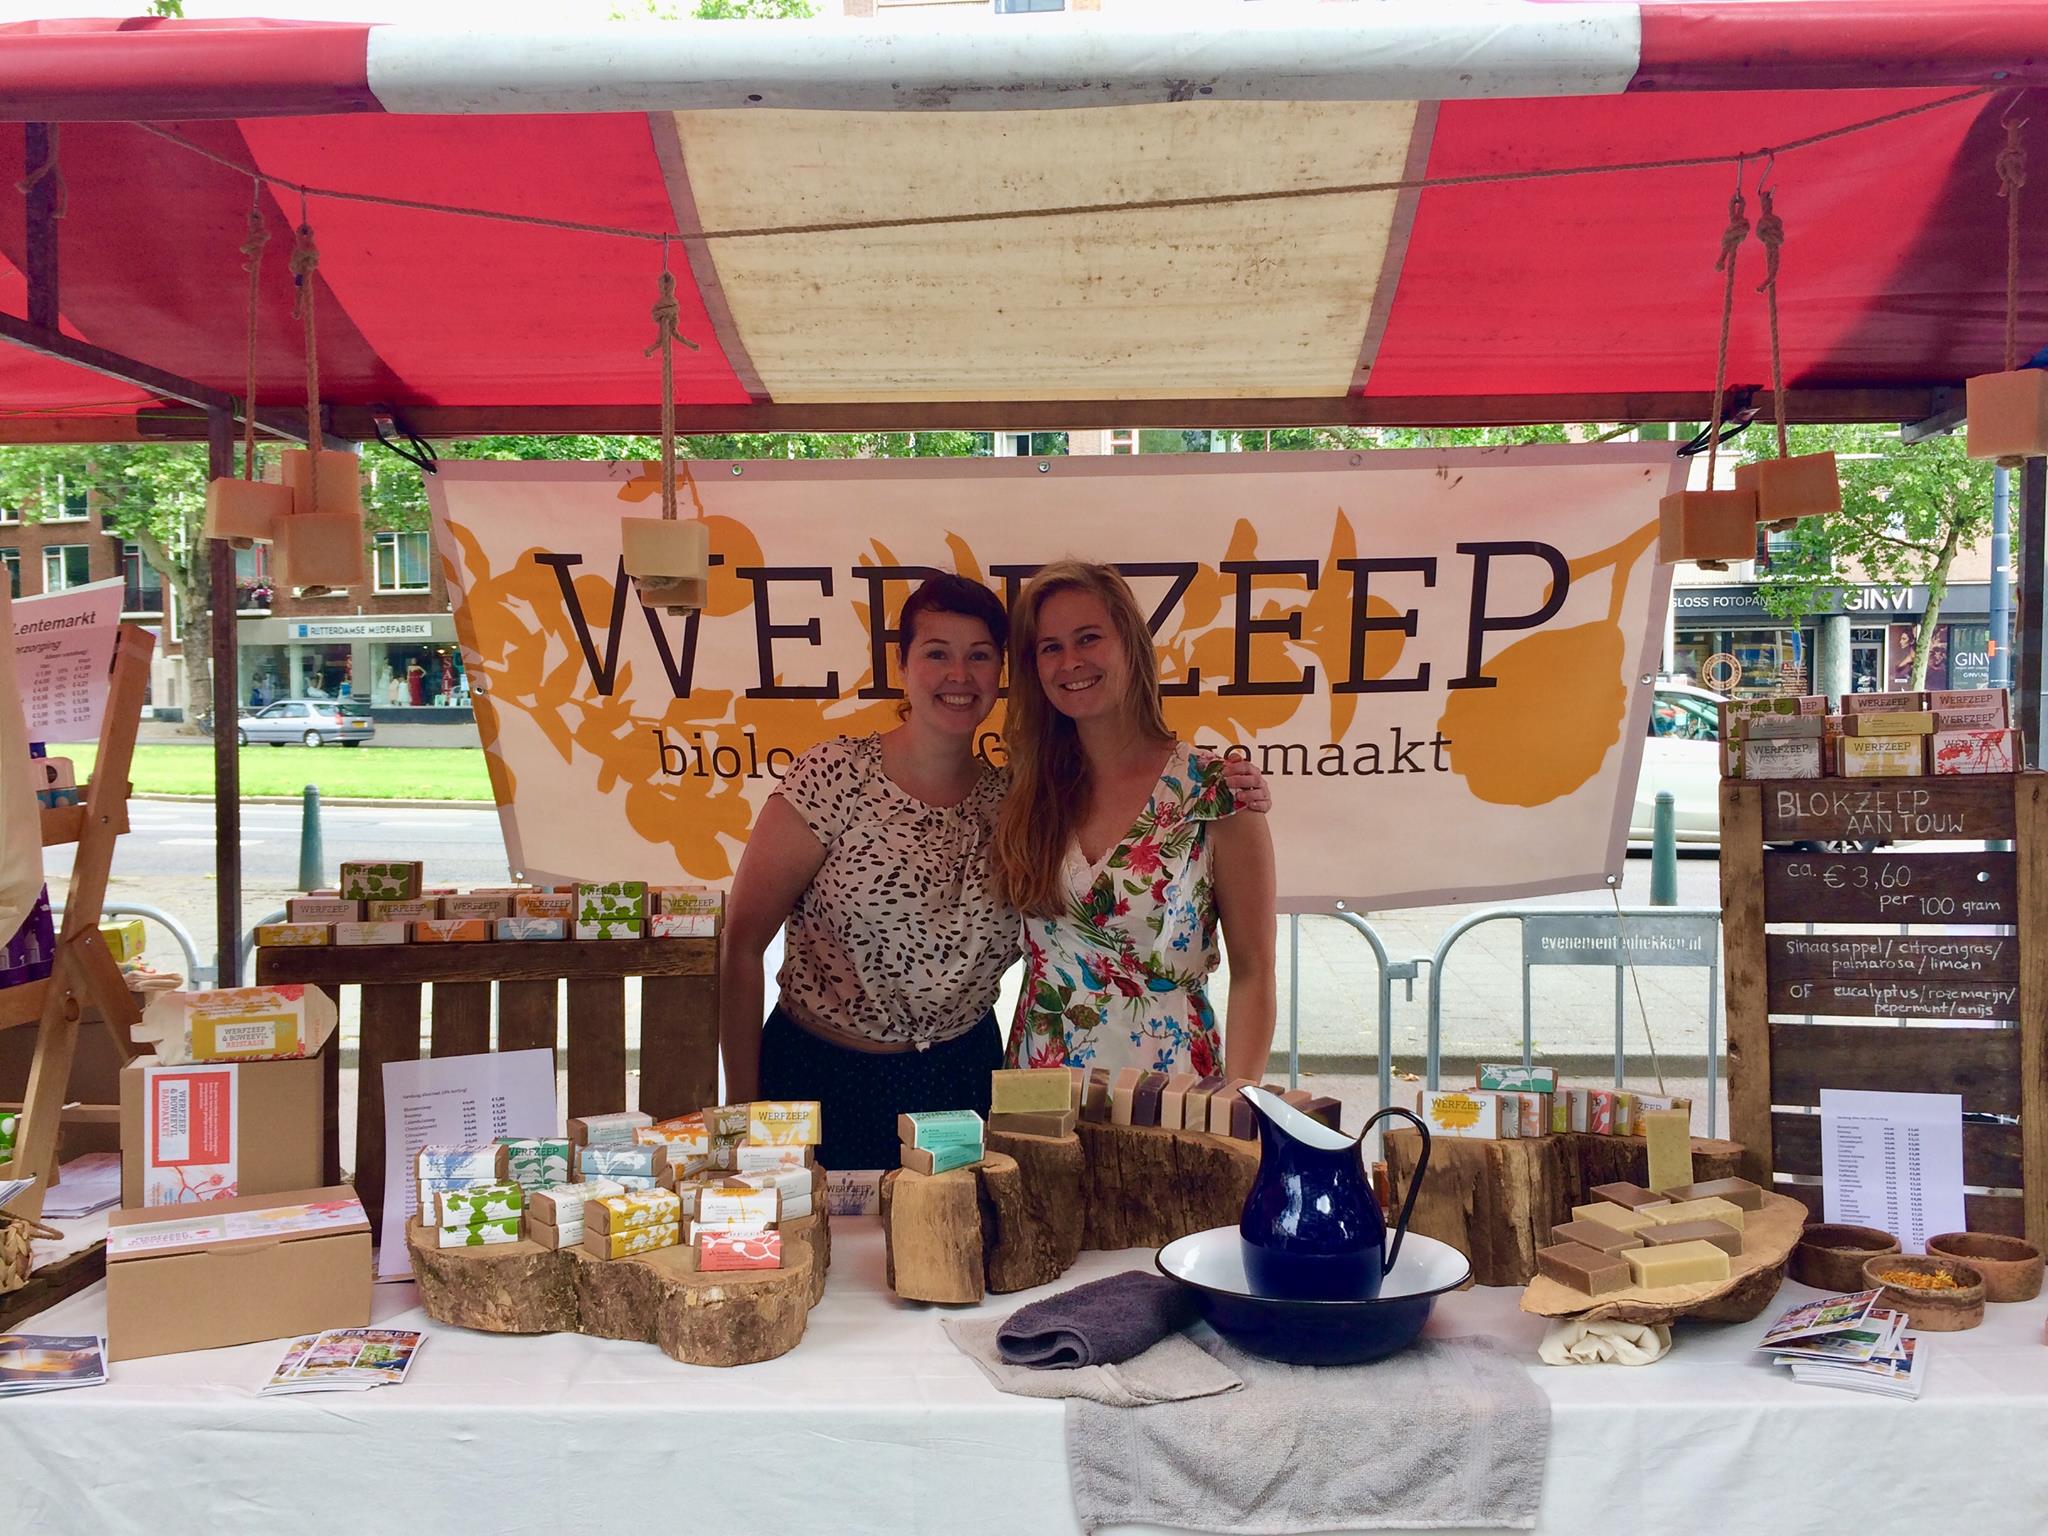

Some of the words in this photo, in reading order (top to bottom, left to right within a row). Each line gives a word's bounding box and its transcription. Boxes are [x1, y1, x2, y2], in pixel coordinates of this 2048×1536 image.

[1843, 587, 1913, 610] GINVI
[1857, 696, 1910, 708] WERFZEEP
[1940, 694, 1993, 705] WERFZEEP
[1941, 713, 1995, 724] WERFZEEP
[1754, 744, 1809, 754] WERFZEEP
[1854, 741, 1911, 751] WERFZEEP
[1777, 790, 1930, 818] BLOKZEEP
[1846, 814, 1892, 835] AAN
[1901, 813, 1964, 834] TOUW
[1787, 862, 1817, 877] ca.
[1852, 862, 1911, 890] 3,60
[525, 899, 571, 908] WERFZEEP
[670, 898, 714, 907] WERFZEEP
[1879, 893, 1914, 912] per
[1919, 897, 1955, 916] 100
[1962, 901, 2001, 917] gram
[300, 905, 350, 914] WERFZEEP
[1790, 984, 1814, 998] OF
[1431, 1098, 1487, 1110] WERFZEEP
[178, 1089, 187, 1135] WERFZEEP
[758, 1111, 809, 1121] WERFZEEP
[827, 1184, 872, 1194] WERFZEEP
